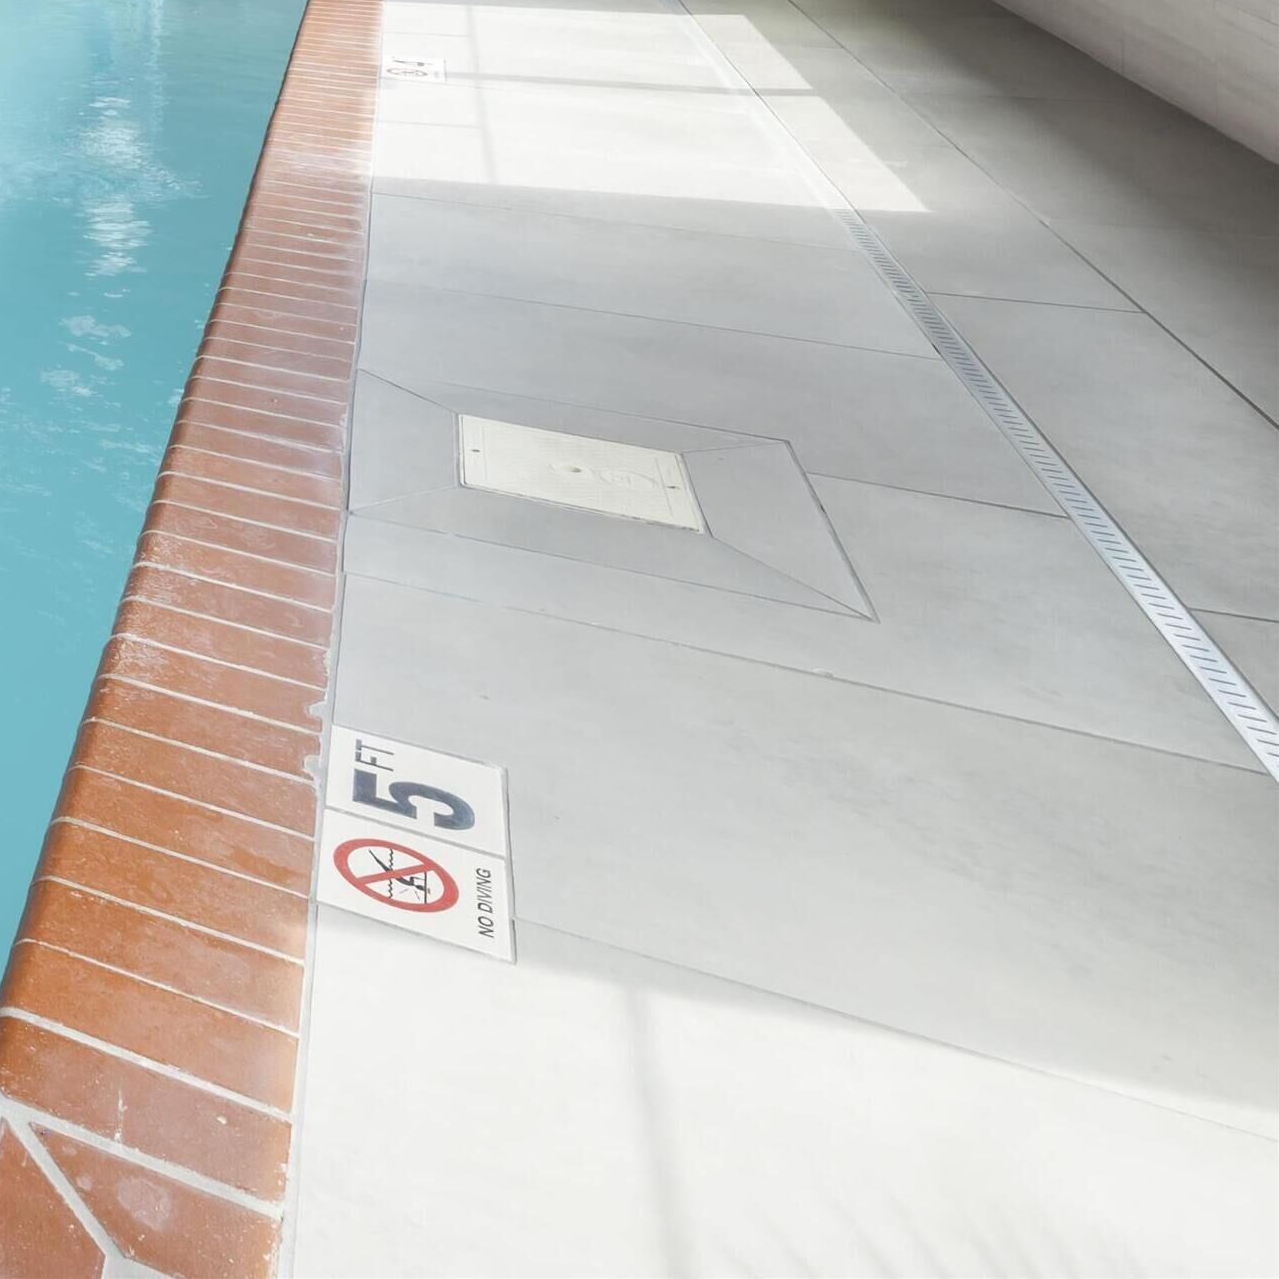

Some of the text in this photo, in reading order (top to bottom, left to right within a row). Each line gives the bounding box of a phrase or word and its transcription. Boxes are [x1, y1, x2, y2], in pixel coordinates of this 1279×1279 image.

[352, 739, 476, 831] 5 FT
[476, 867, 495, 939] NO DIVING
